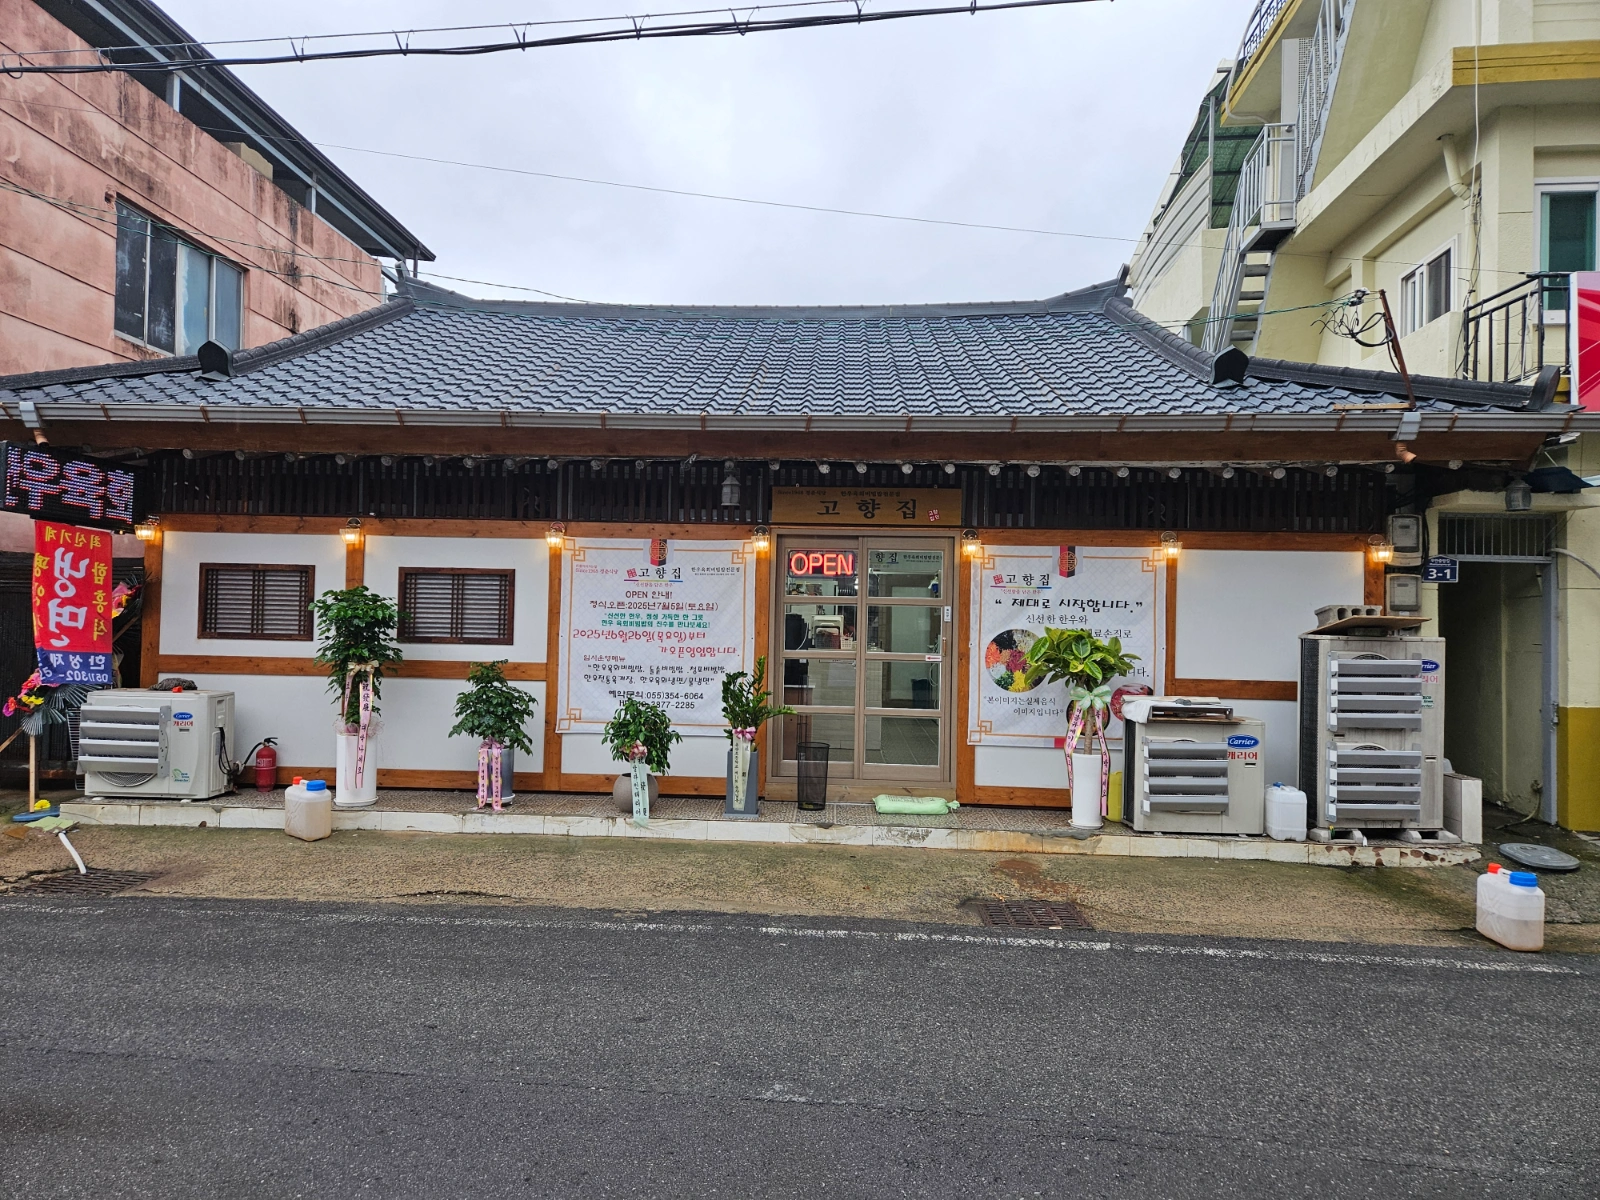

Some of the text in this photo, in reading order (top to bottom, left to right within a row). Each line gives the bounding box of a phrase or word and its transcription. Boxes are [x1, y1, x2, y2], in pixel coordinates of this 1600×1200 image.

[791, 552, 854, 575] OPEN
[1428, 568, 1451, 579] 3-1
[625, 590, 673, 600] OPEN 안내!
[1011, 597, 1051, 609] 제대로
[1025, 613, 1057, 624] 신선한
